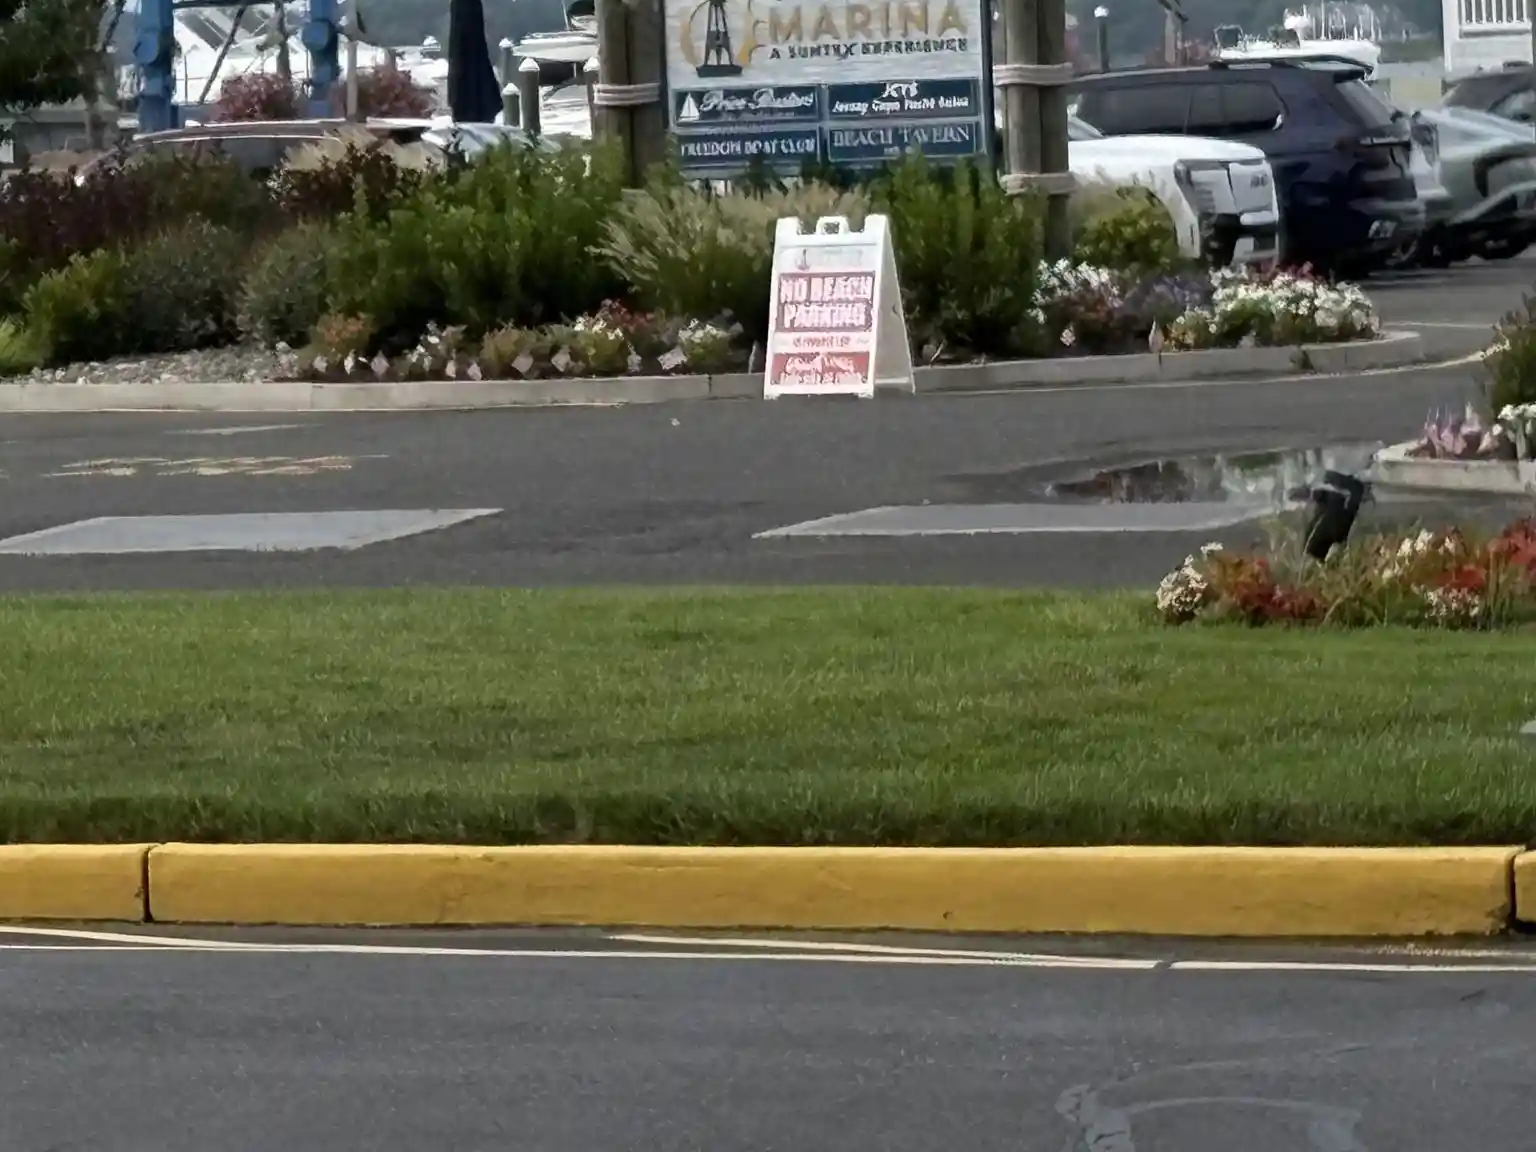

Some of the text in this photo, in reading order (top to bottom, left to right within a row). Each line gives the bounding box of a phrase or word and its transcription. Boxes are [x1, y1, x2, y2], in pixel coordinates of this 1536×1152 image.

[769, 47, 781, 60] A
[744, 137, 778, 154] BOAT
[780, 135, 815, 153] CLUB
[833, 124, 970, 147] BEACH TAVERN
[779, 277, 807, 303] NO
